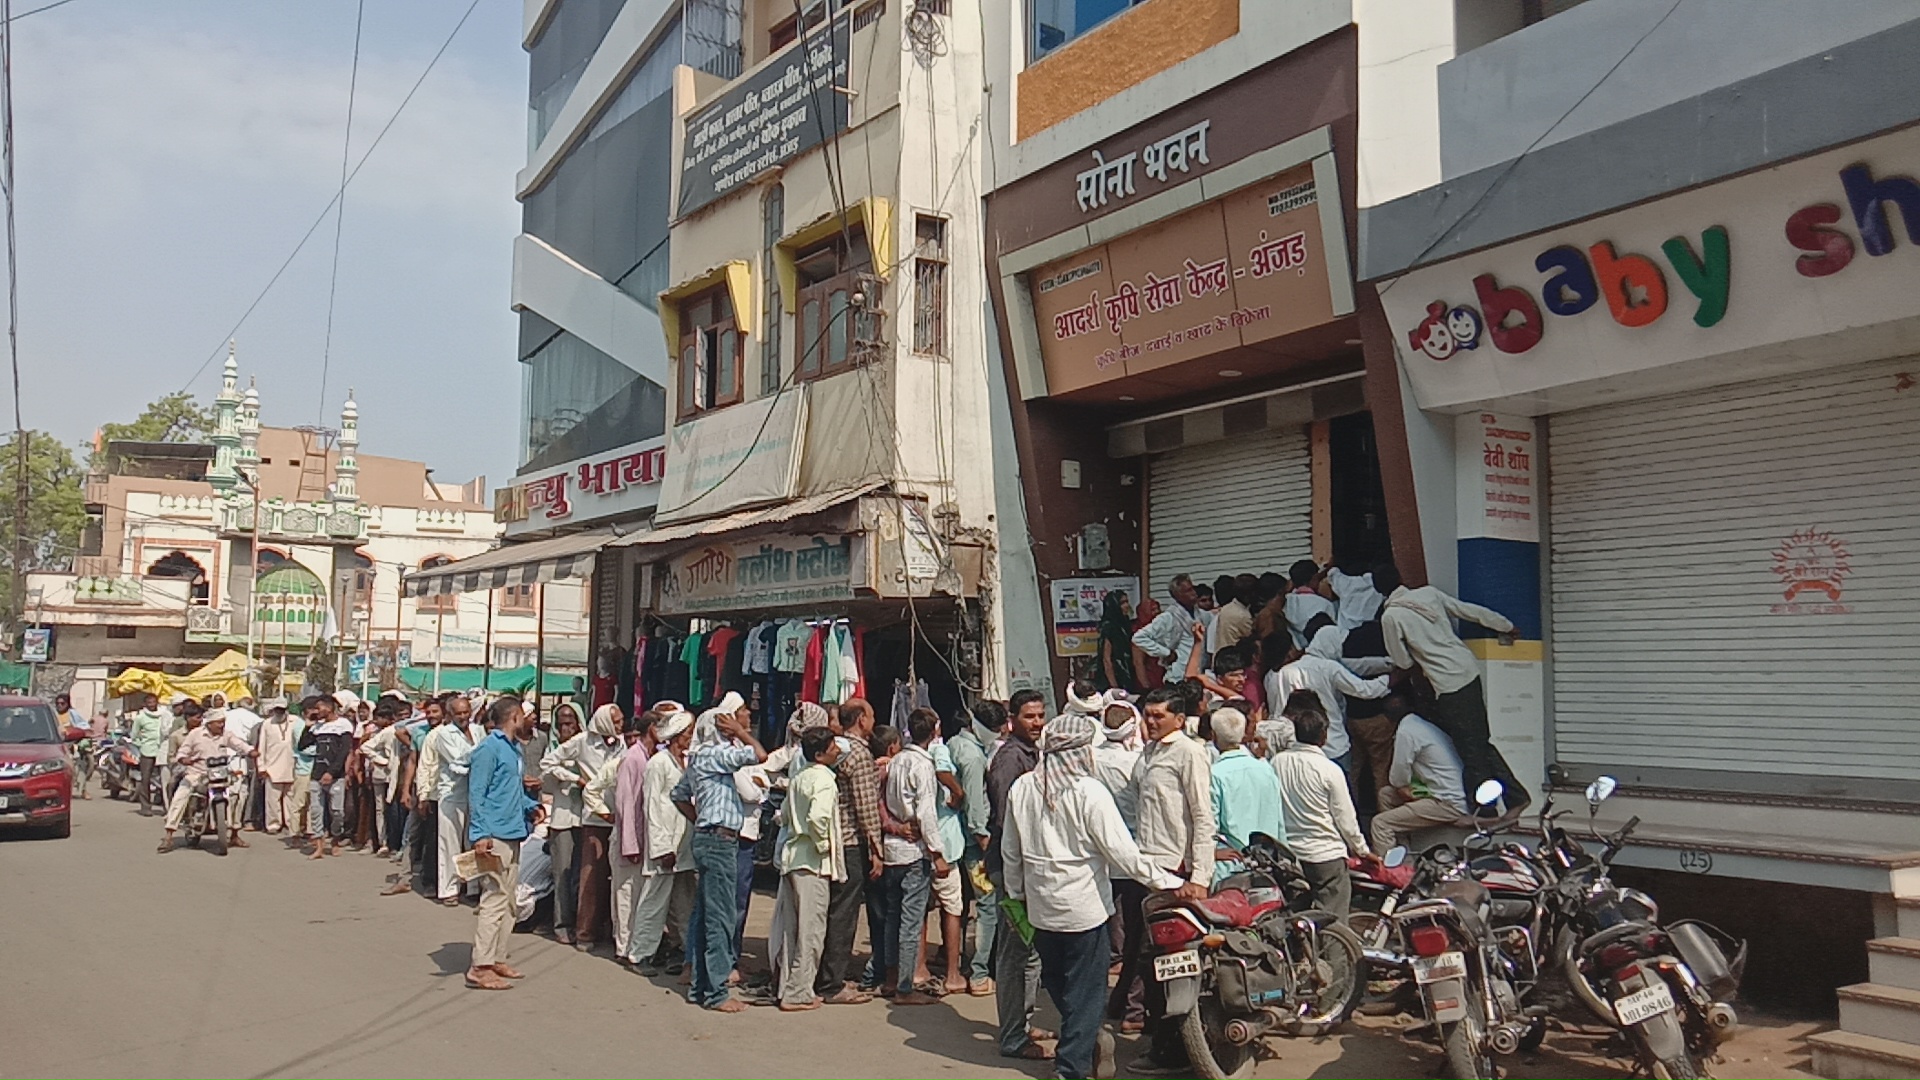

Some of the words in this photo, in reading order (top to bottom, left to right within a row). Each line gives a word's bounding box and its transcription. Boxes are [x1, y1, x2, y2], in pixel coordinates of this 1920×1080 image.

[1076, 149, 1137, 213] सोना
[1143, 119, 1210, 182] भवन
[1054, 292, 1101, 341] आदर्श
[1104, 282, 1139, 335] कृषि
[1144, 272, 1181, 312] सेवा
[1184, 258, 1228, 298] केन्द्र
[1250, 231, 1306, 279] अंजड़
[1472, 225, 1731, 354] baby
[686, 548, 732, 593] गणेश
